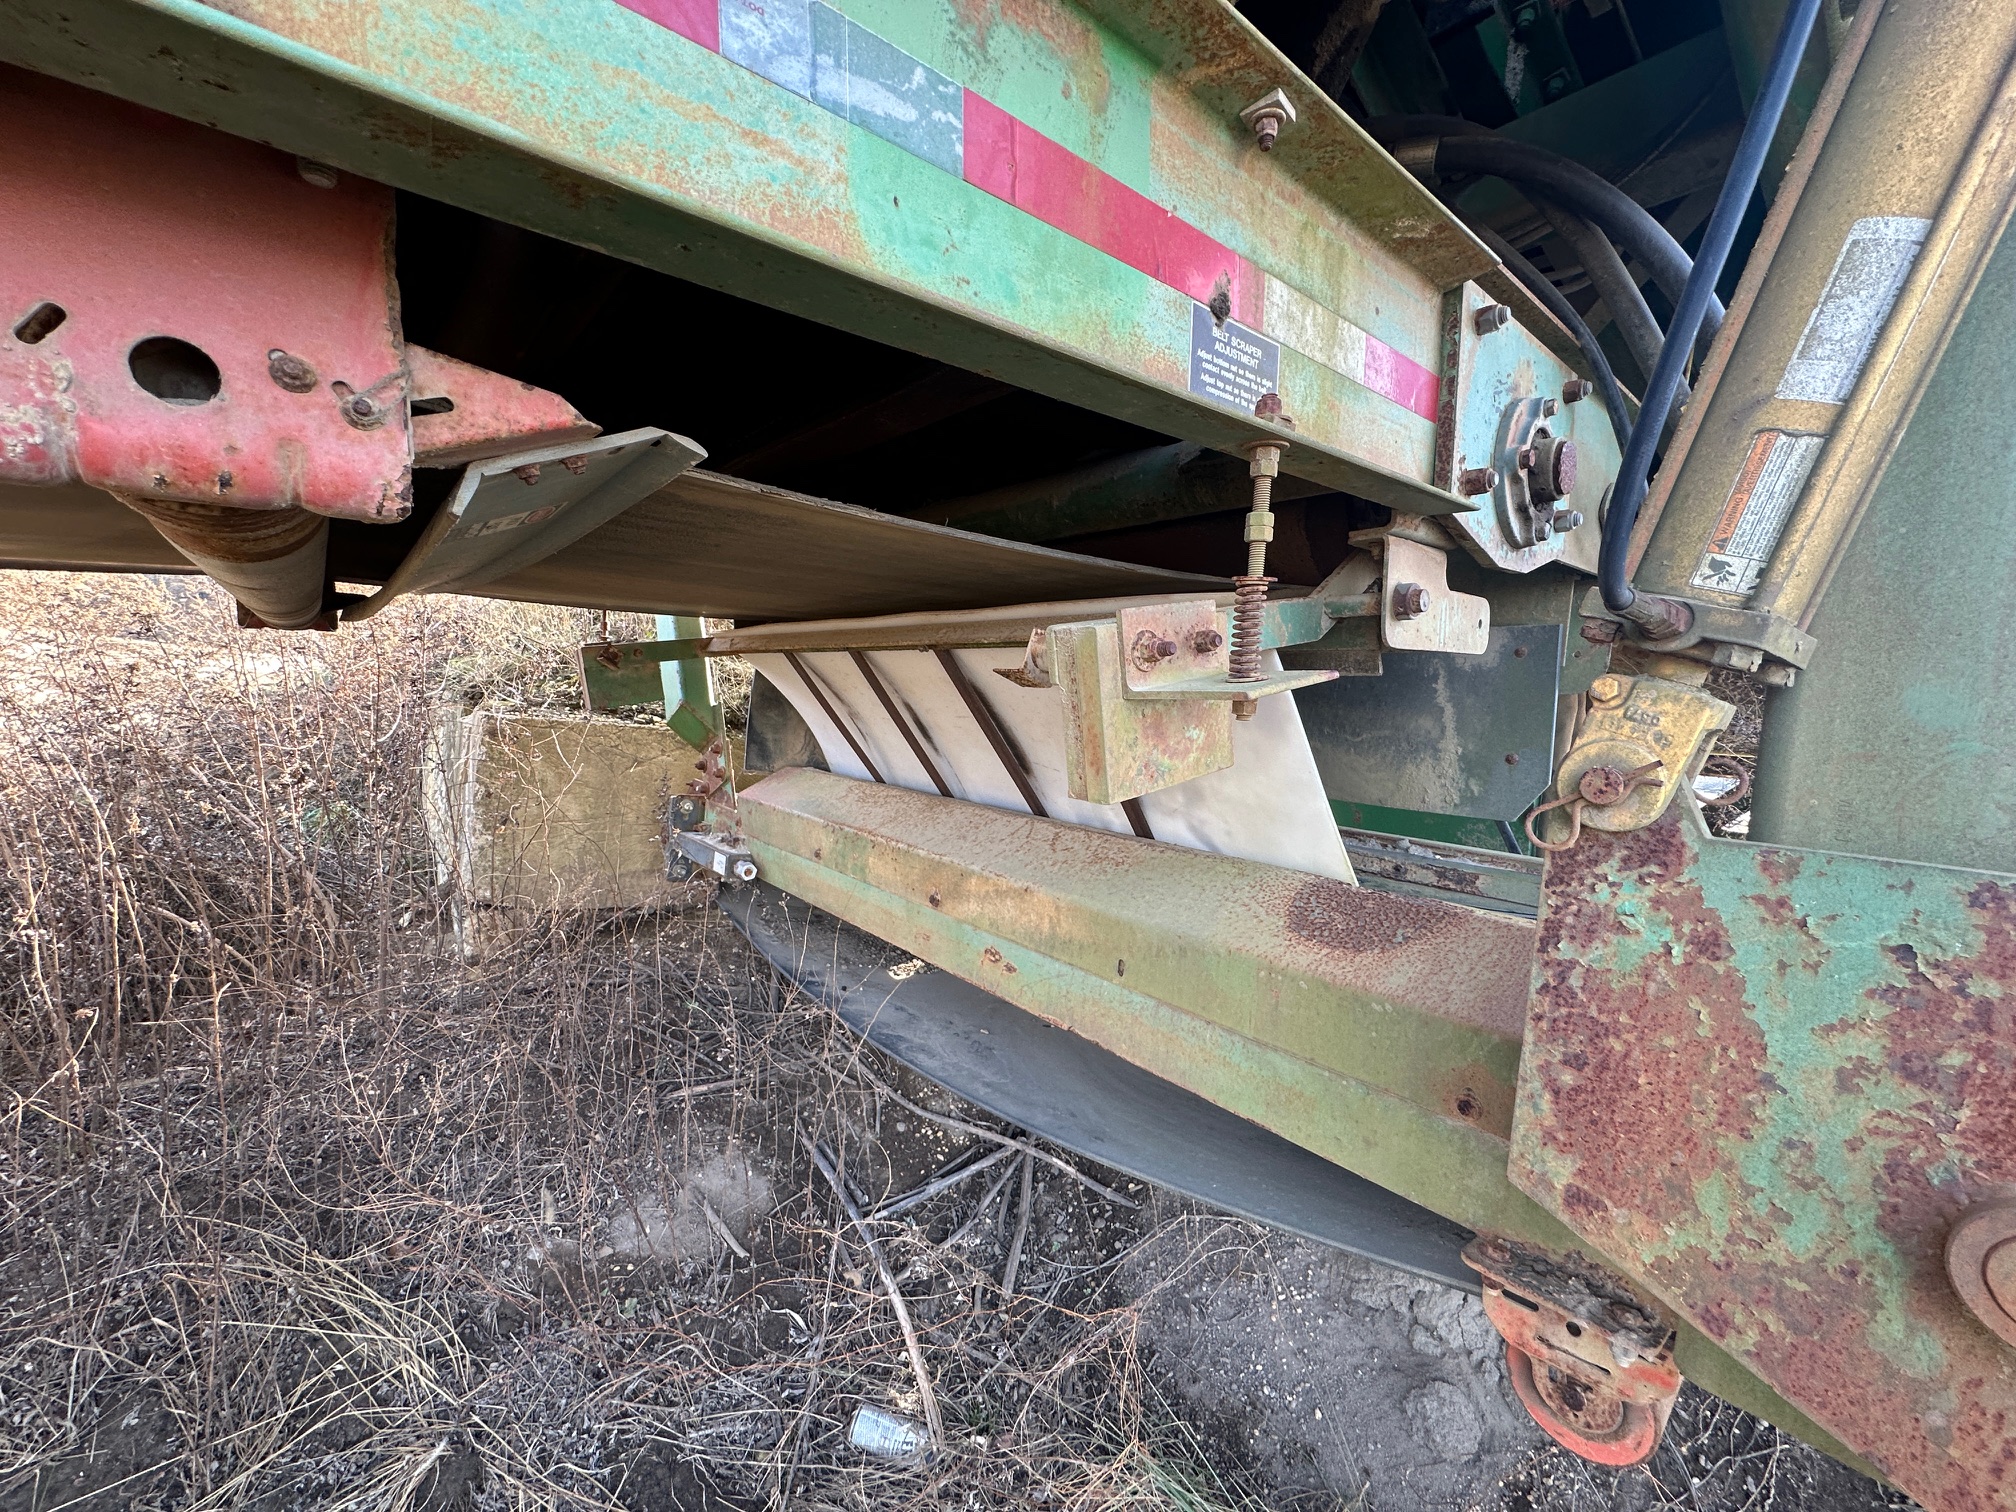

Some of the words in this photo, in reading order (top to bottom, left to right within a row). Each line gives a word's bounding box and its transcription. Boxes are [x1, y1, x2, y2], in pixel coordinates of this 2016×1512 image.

[1212, 326, 1229, 342] BELT
[1231, 336, 1263, 358] SCRAPER
[1214, 341, 1259, 370] ADJUSTMENT
[1720, 496, 1743, 535] WARNING
